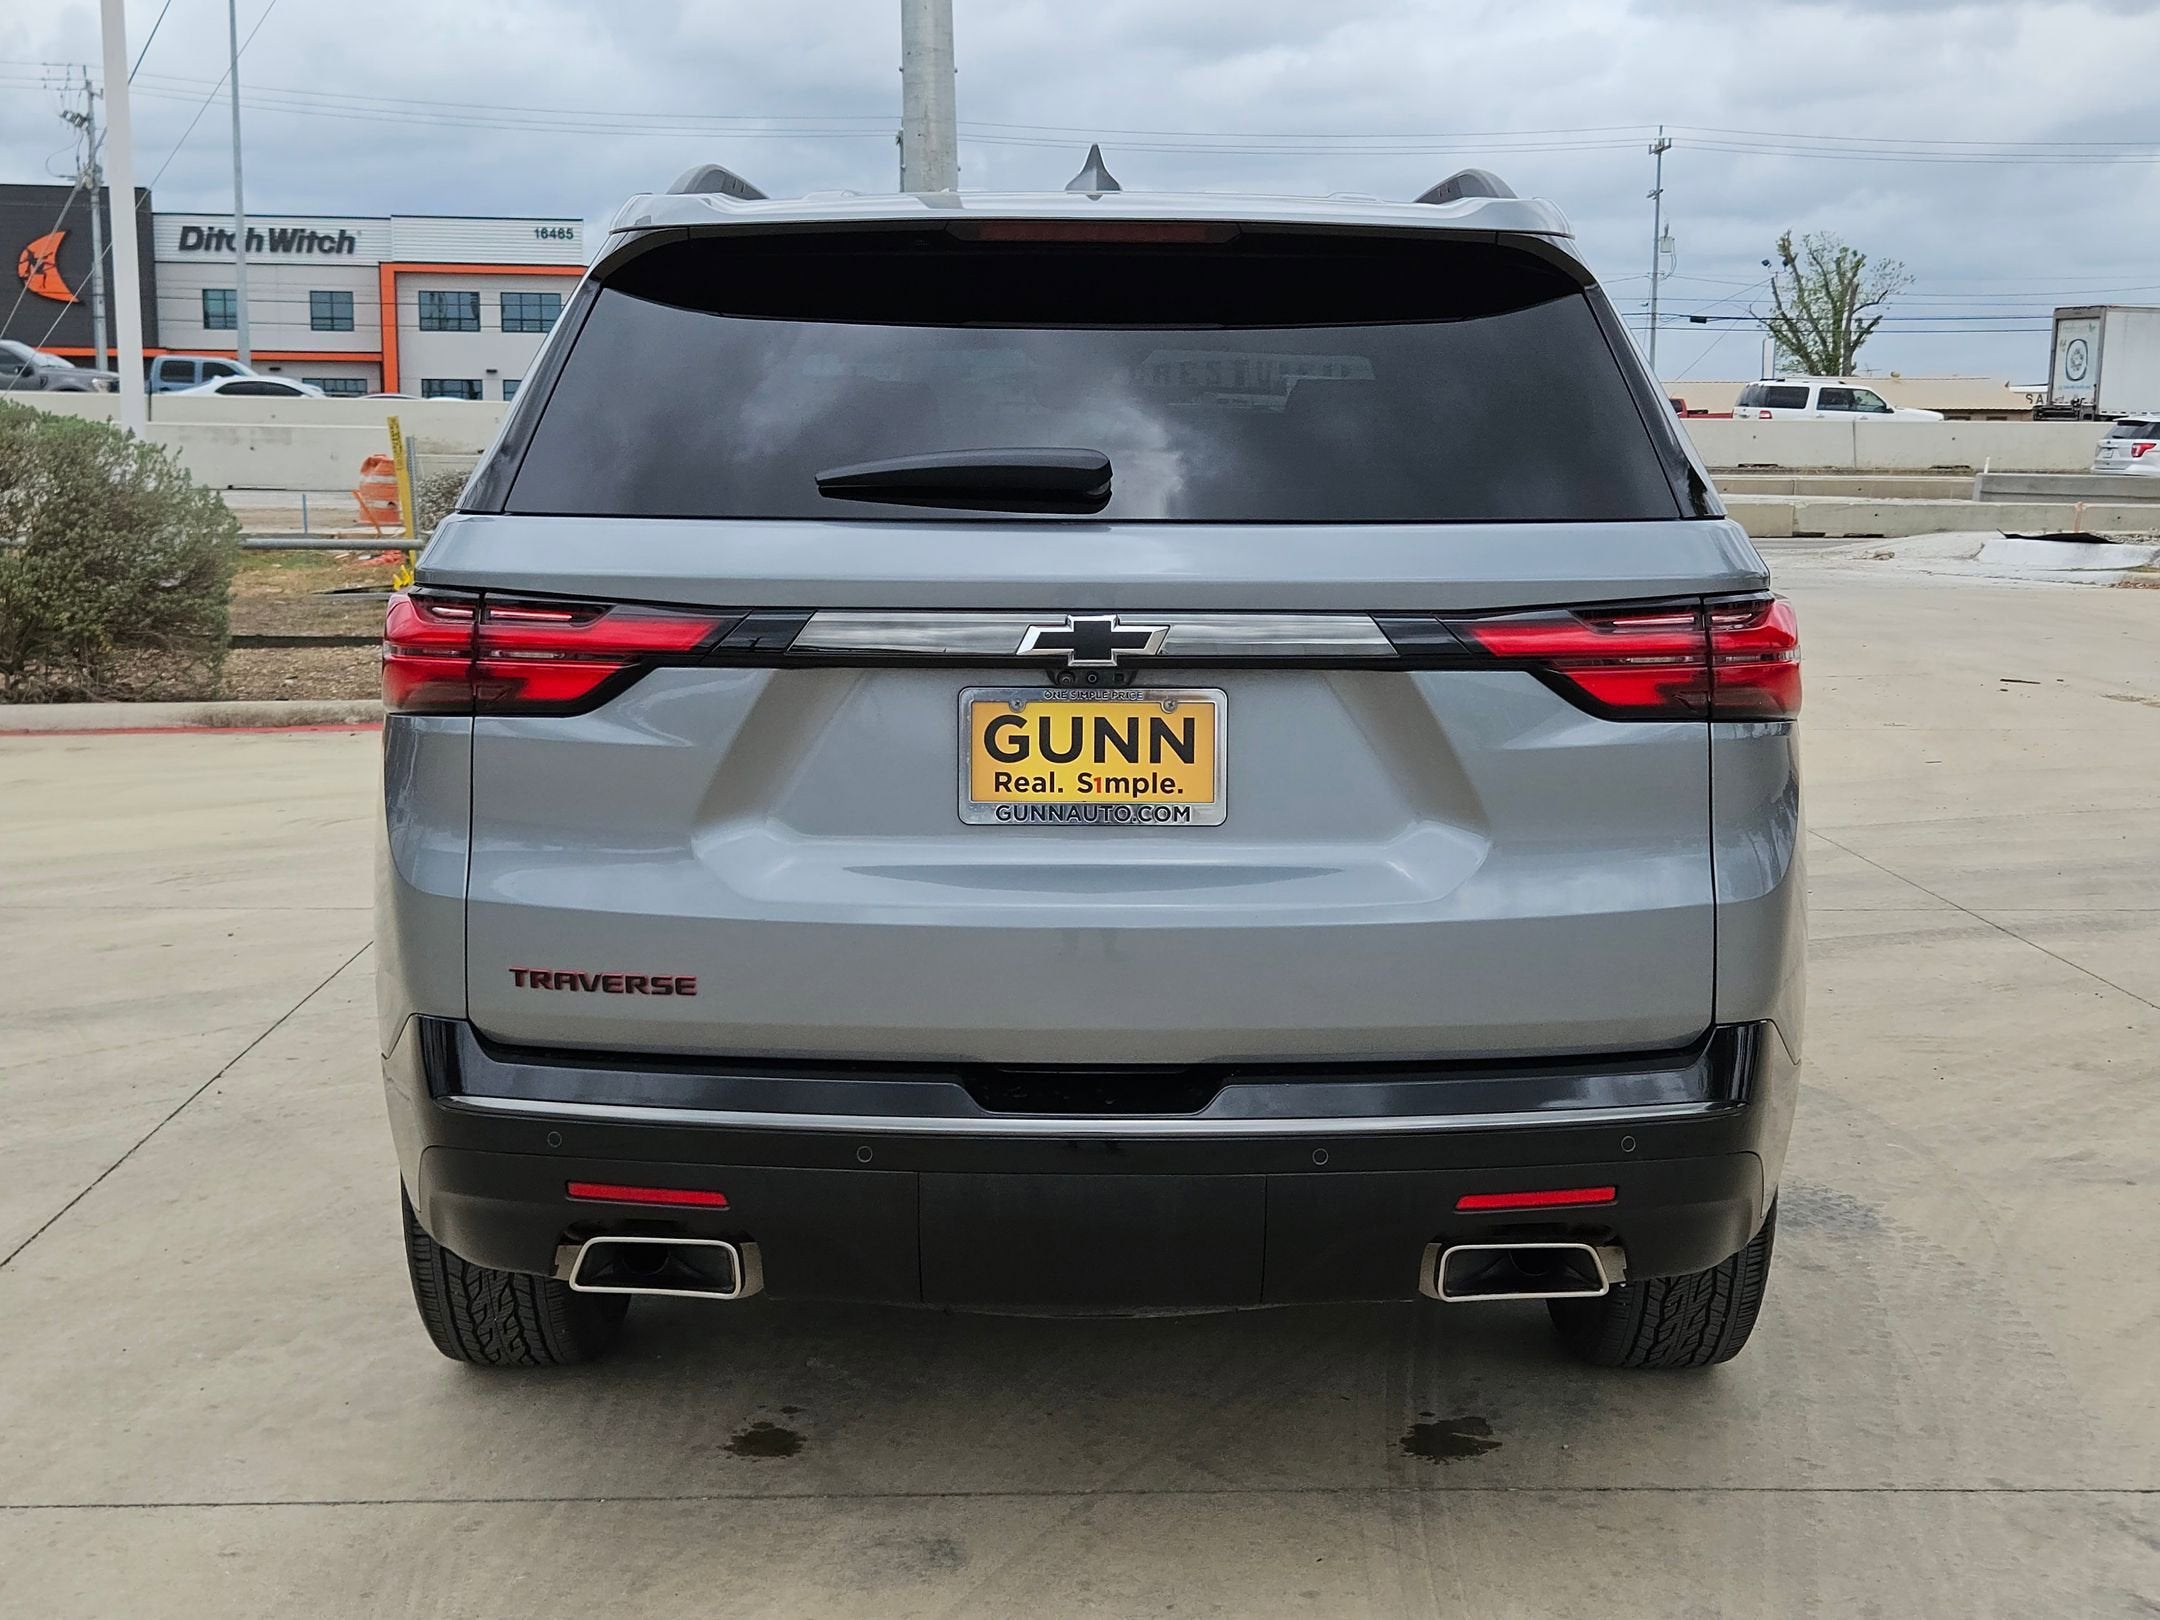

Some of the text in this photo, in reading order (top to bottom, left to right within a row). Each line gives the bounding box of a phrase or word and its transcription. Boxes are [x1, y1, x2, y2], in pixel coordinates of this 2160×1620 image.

[268, 227, 356, 254] Witch
[534, 227, 574, 240] 16465
[1043, 690, 1143, 701] ONE SIMPLE PRICE
[983, 714, 1196, 764] GUNN
[994, 772, 1184, 798] Real. S1mple.
[995, 804, 1191, 824] GUNNAUTO.COM
[508, 966, 698, 997] TRAVERSE
